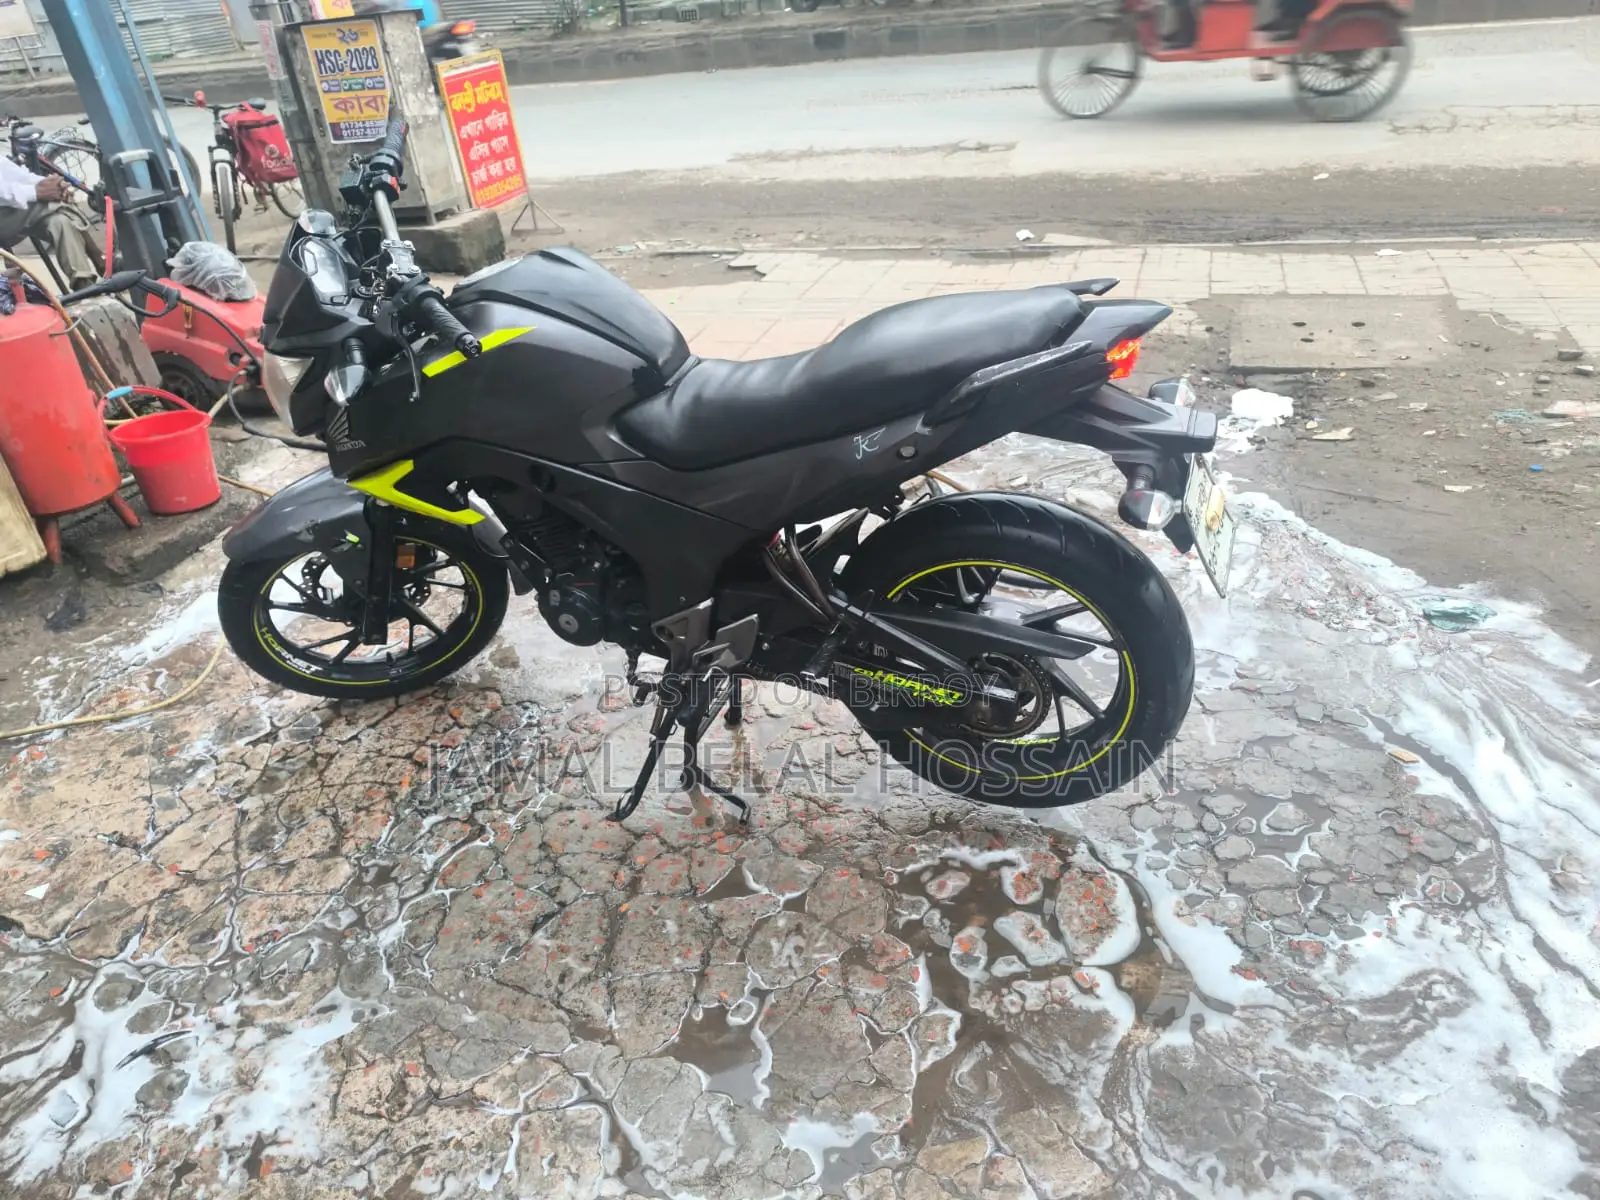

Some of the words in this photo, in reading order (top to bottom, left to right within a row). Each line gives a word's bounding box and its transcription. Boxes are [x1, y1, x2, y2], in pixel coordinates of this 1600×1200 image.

[313, 46, 379, 76] HSC-2028
[335, 440, 367, 452] HONDA
[260, 627, 323, 671] HORNET
